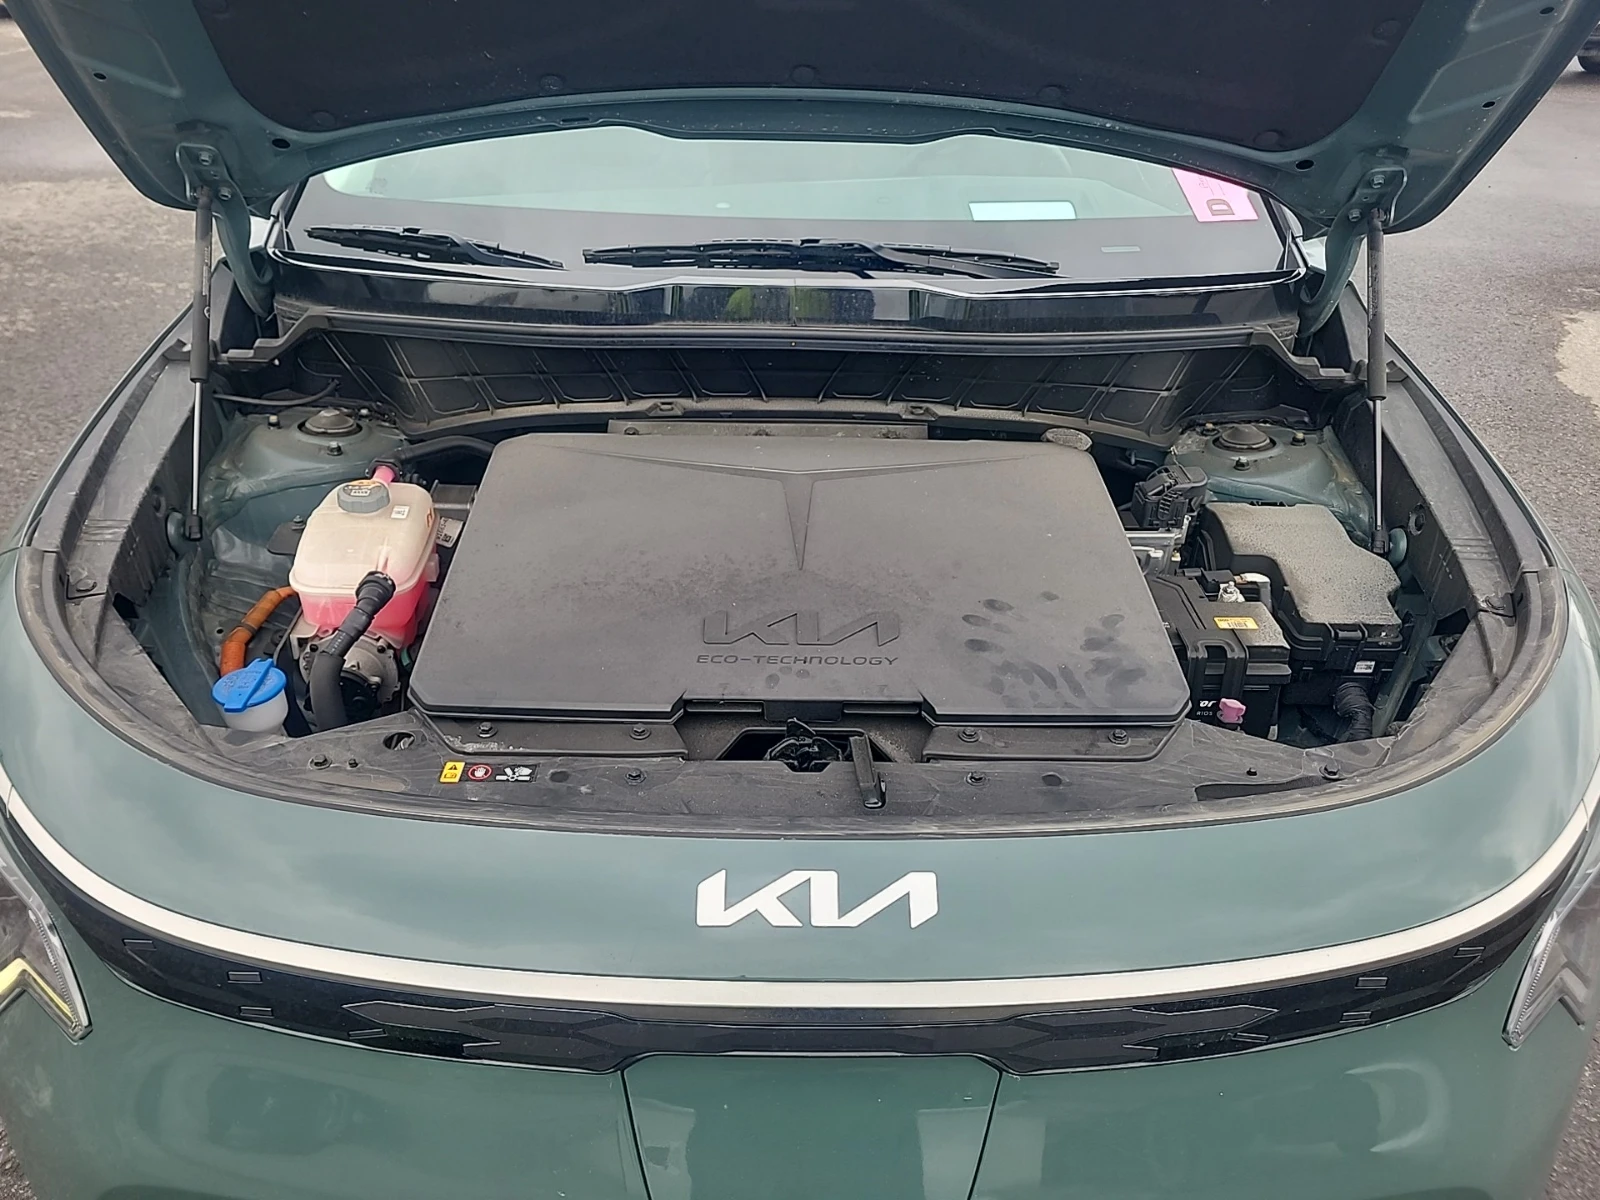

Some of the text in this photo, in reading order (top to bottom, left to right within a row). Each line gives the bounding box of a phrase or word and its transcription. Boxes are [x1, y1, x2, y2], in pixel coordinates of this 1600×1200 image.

[1206, 198, 1235, 216] D
[696, 654, 899, 666] ECO-TECHNOLOGY
[1199, 700, 1217, 708] or
[695, 868, 939, 929] KIA
